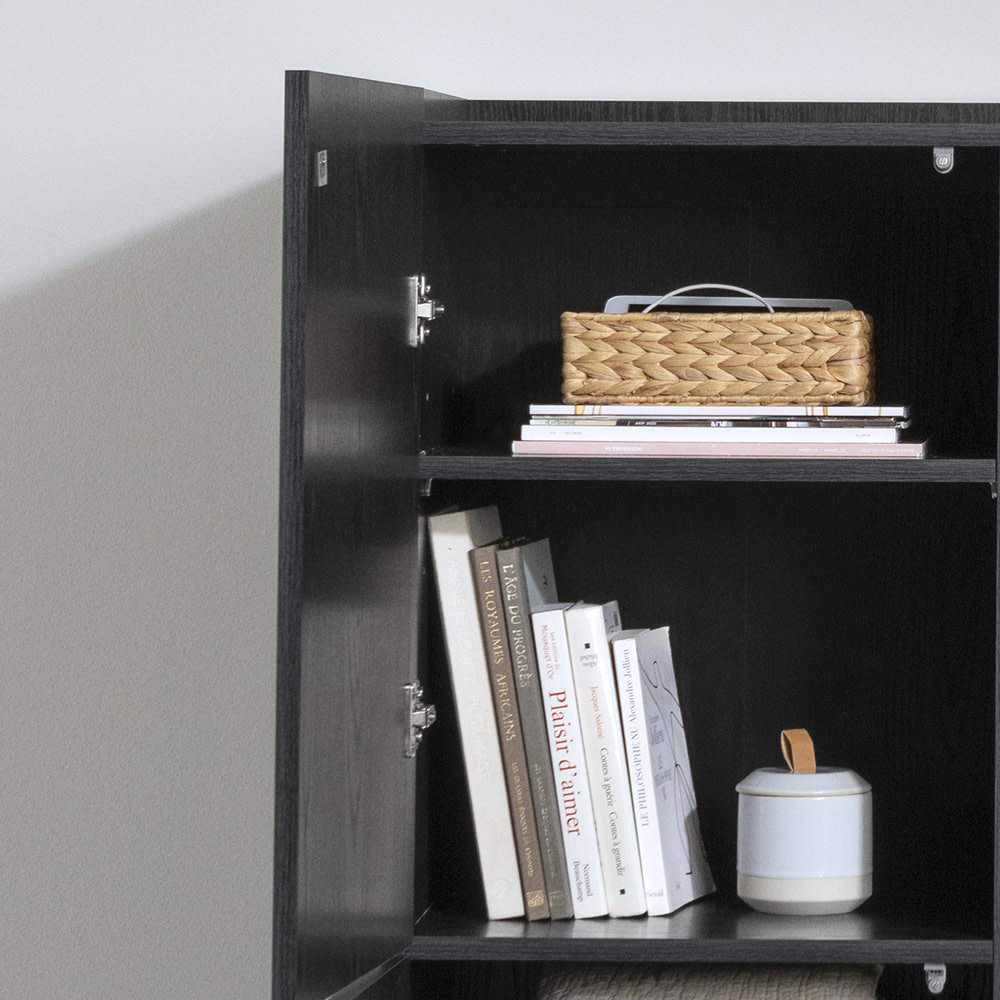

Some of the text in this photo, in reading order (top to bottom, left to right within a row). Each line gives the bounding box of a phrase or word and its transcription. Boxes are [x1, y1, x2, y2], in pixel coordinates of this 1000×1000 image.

[502, 564, 532, 687] L'ÂGE DU PROGRÈS
[480, 561, 515, 741] LES ROYAUMES AFRICAINS
[588, 685, 604, 739] Jacques Salomé
[625, 679, 636, 722] Alexandre
[548, 690, 580, 836] Plaisir d'aimer
[599, 747, 608, 775] Contes
[632, 741, 647, 809] PHILOSOPHE
[601, 783, 614, 806] guérir
[608, 811, 618, 840] Contes
[640, 811, 649, 826] LE
[572, 860, 583, 902] Beauchamp
[582, 862, 593, 896] Normand
[611, 847, 625, 875] grandir
